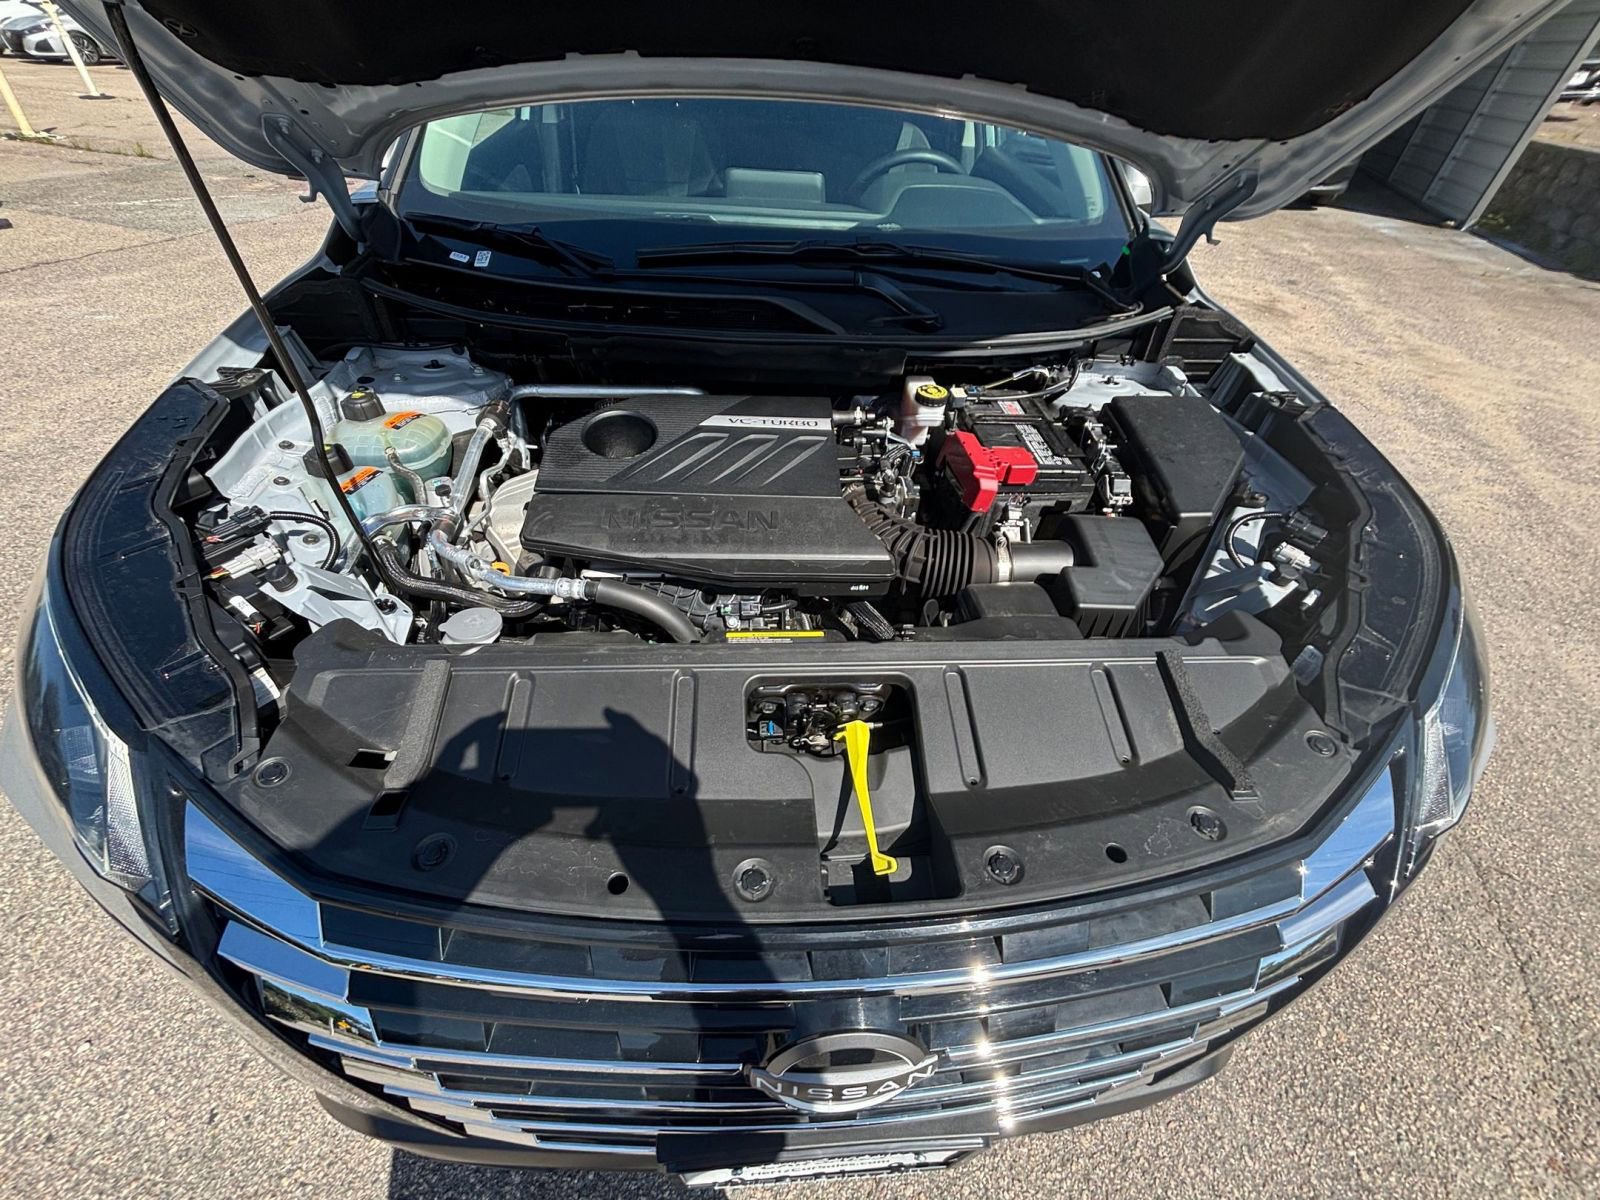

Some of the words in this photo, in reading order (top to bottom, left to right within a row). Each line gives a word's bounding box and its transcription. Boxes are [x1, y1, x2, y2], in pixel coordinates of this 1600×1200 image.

[728, 417, 818, 427] VC-TURBO
[603, 510, 779, 530] NISSAN
[756, 1065, 933, 1099] NISSAN
